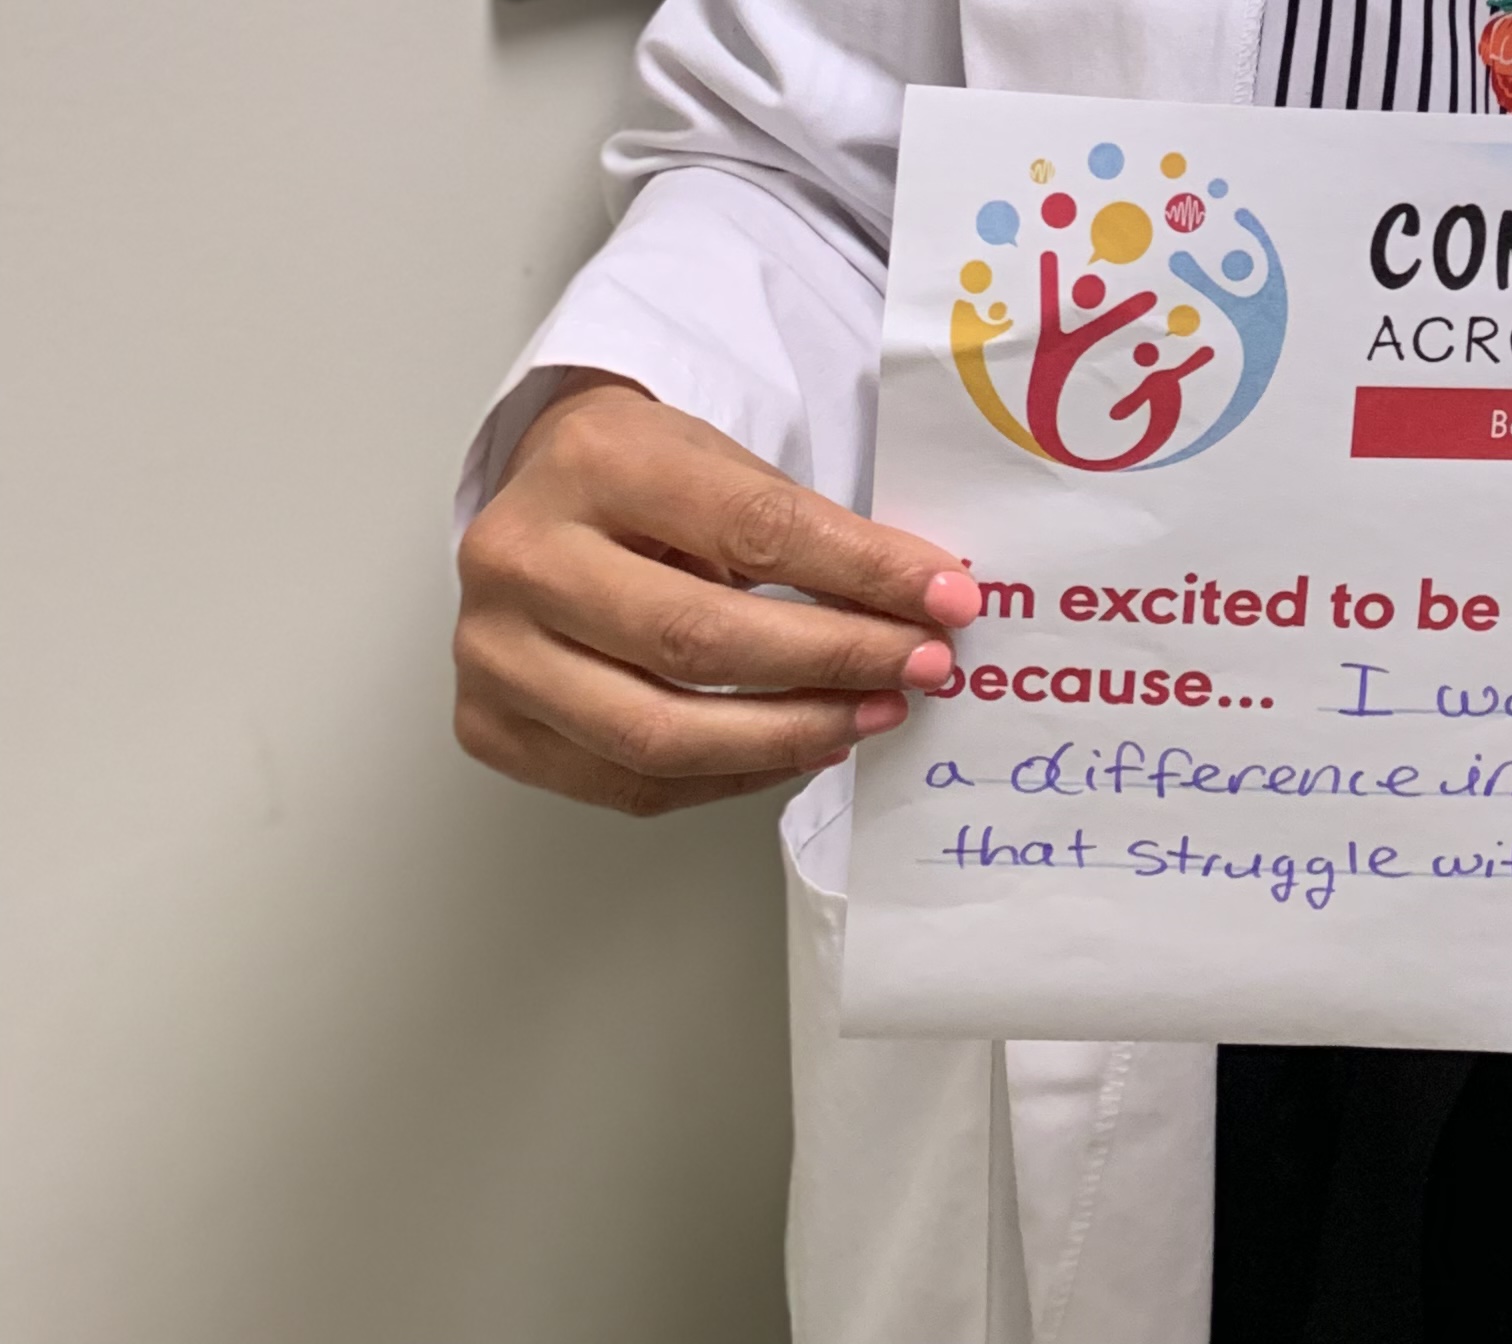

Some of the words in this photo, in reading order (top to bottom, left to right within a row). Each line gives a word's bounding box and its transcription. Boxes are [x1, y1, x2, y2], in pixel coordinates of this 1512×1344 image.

[1058, 572, 1310, 628] excited
[1330, 583, 1396, 630] to
[1416, 577, 1501, 632] be
[1338, 662, 1393, 717] I
[924, 761, 976, 788] a
[1010, 741, 1422, 799] difference
[942, 824, 1098, 868] that
